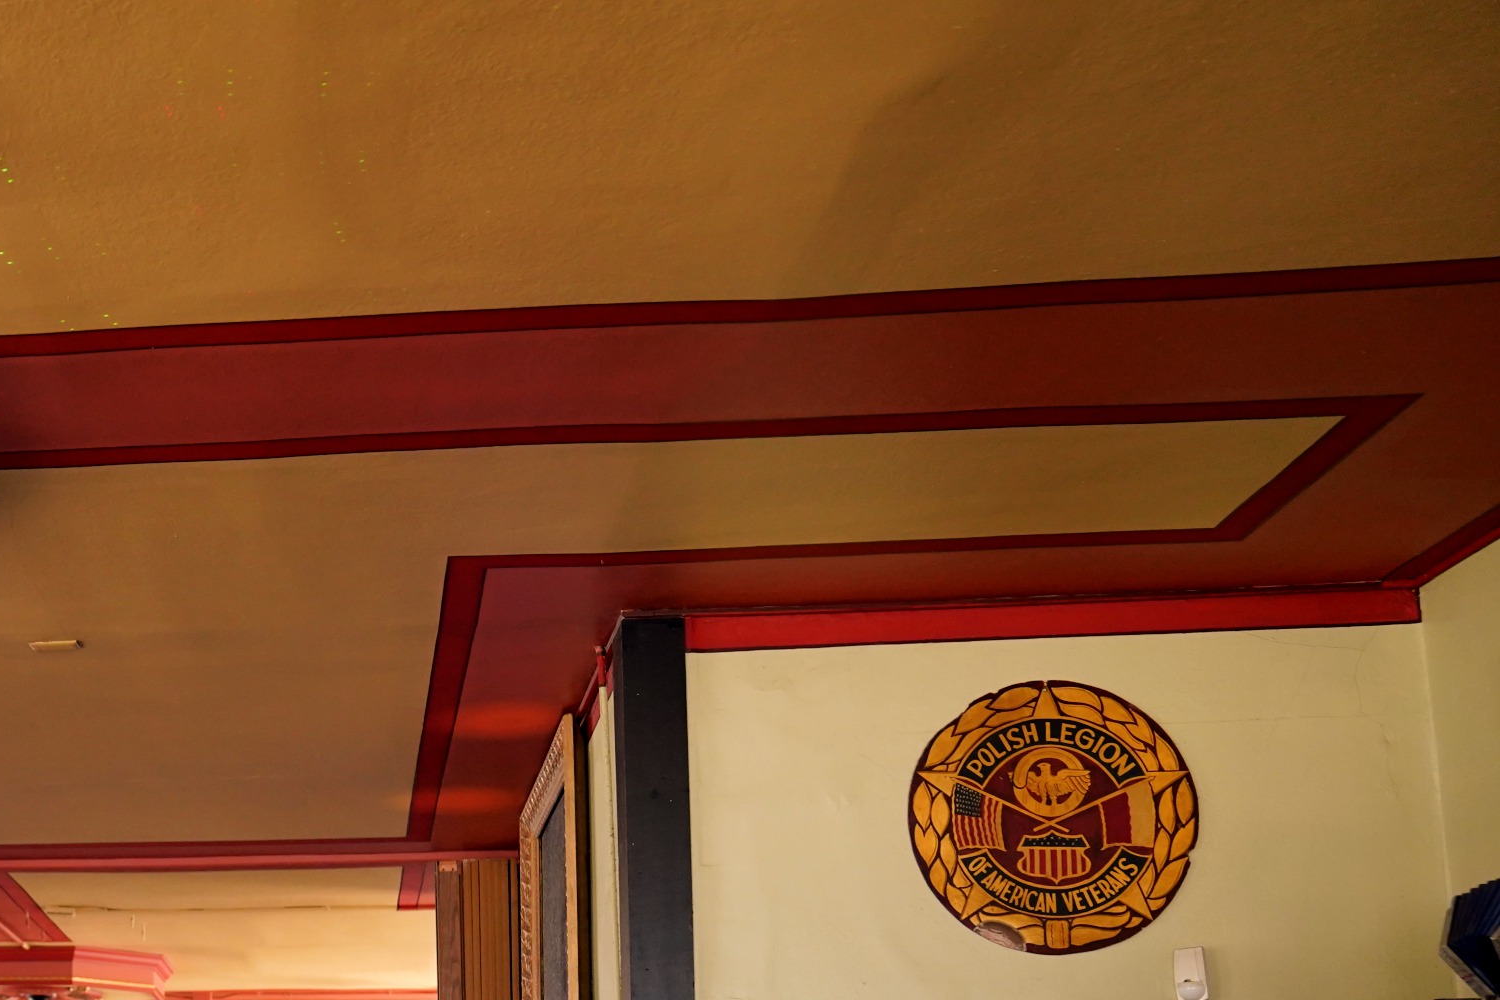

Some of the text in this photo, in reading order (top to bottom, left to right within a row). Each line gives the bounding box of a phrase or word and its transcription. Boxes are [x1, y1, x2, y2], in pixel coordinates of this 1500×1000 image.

[966, 721, 1136, 779] POLISH LEGION
[969, 857, 1139, 914] OF AMERICAN VETERANS
